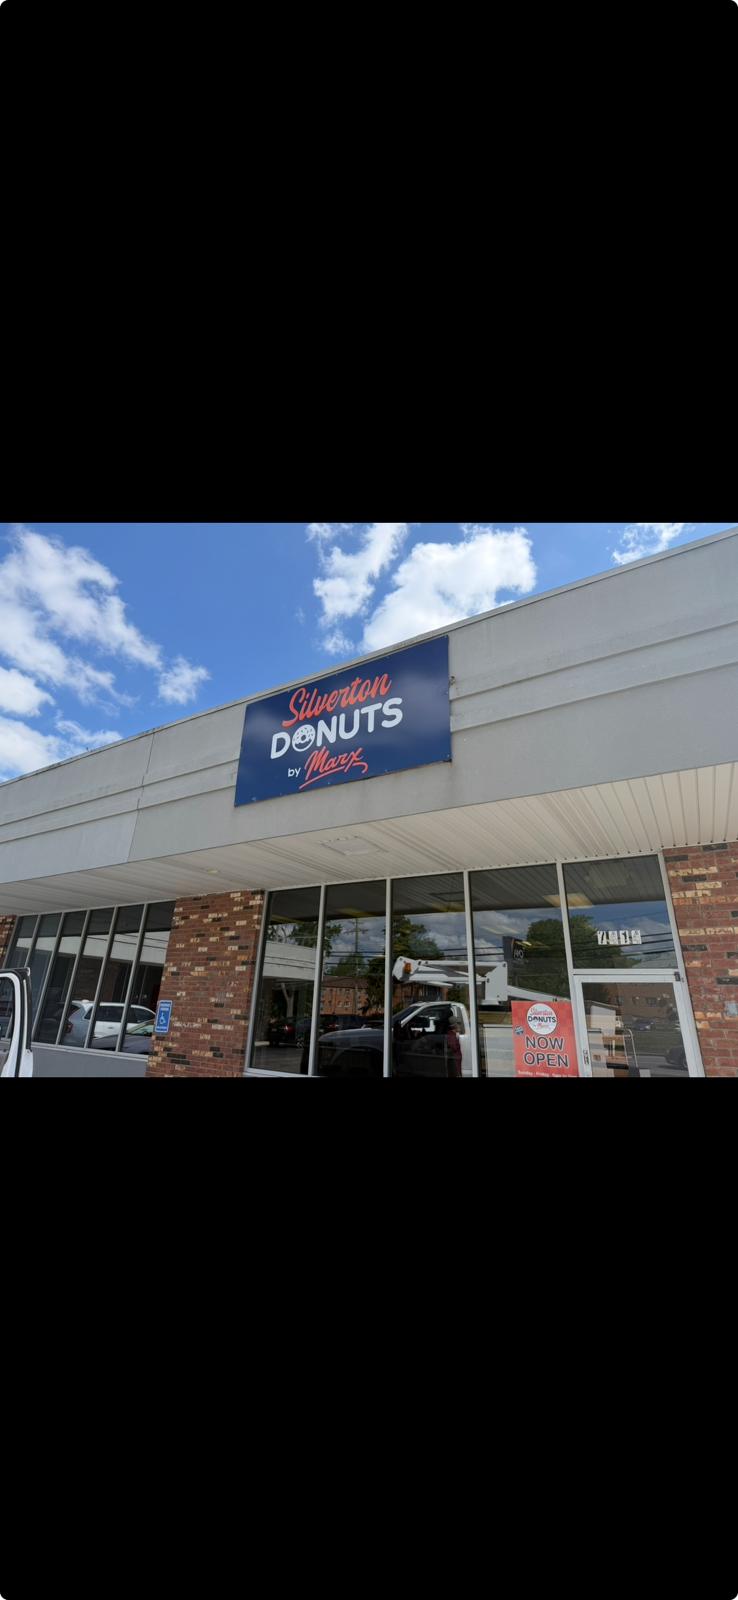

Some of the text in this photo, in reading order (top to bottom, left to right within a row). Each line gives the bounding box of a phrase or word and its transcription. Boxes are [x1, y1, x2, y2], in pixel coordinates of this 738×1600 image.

[282, 673, 391, 728] Silverton
[270, 697, 403, 759] DONUTS
[287, 746, 366, 784] by Marx
[527, 1015, 557, 1024] DONUTS
[525, 1036, 564, 1051] NOW
[524, 1052, 569, 1067] OPEN
